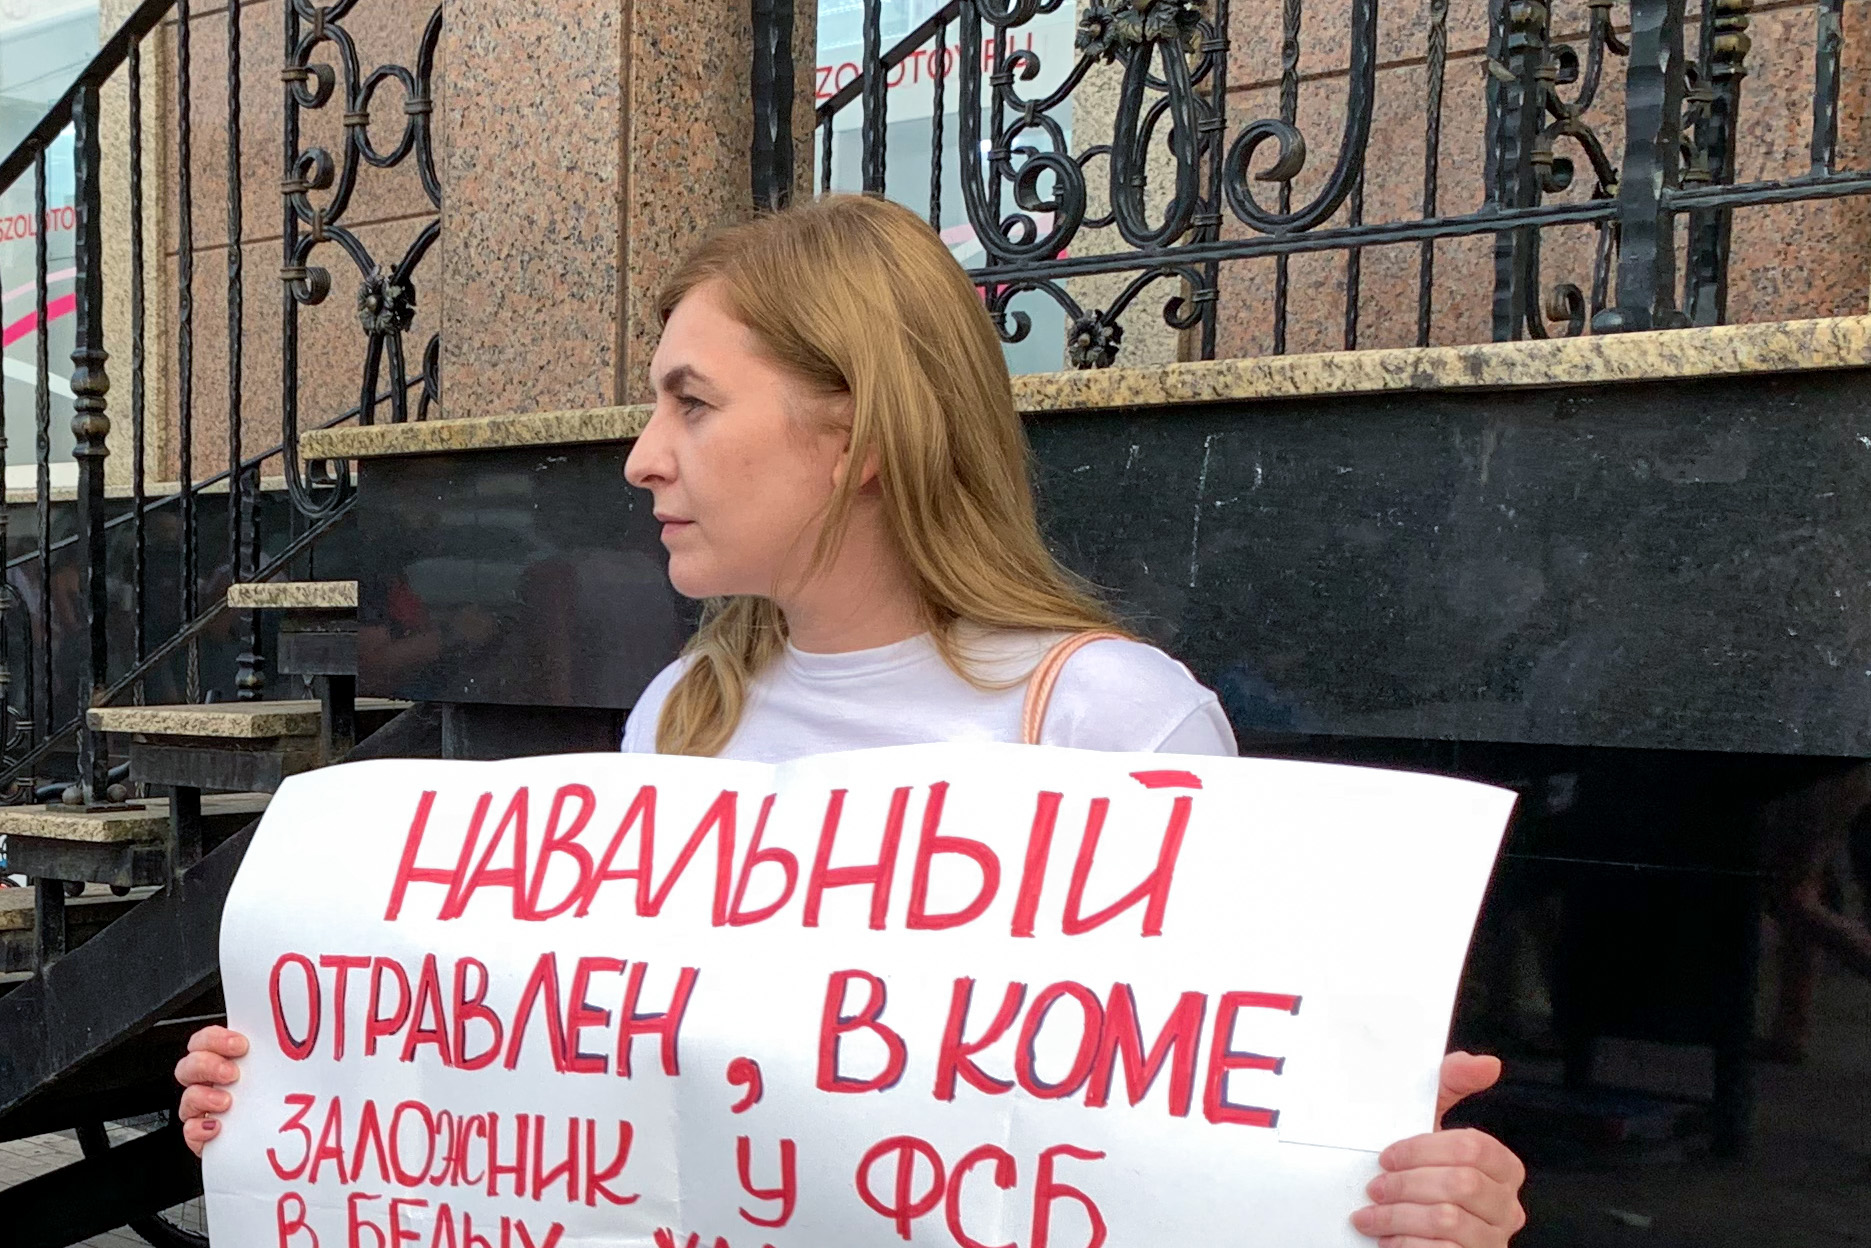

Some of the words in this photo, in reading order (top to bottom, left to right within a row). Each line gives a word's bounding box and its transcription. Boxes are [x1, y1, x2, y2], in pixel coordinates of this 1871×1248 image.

[384, 770, 1204, 938] НАВАЛЬНЫЙ
[816, 968, 909, 1095] В
[933, 976, 1302, 1129] КОМЕ
[266, 1093, 640, 1207] ЗАЛОЖНИК
